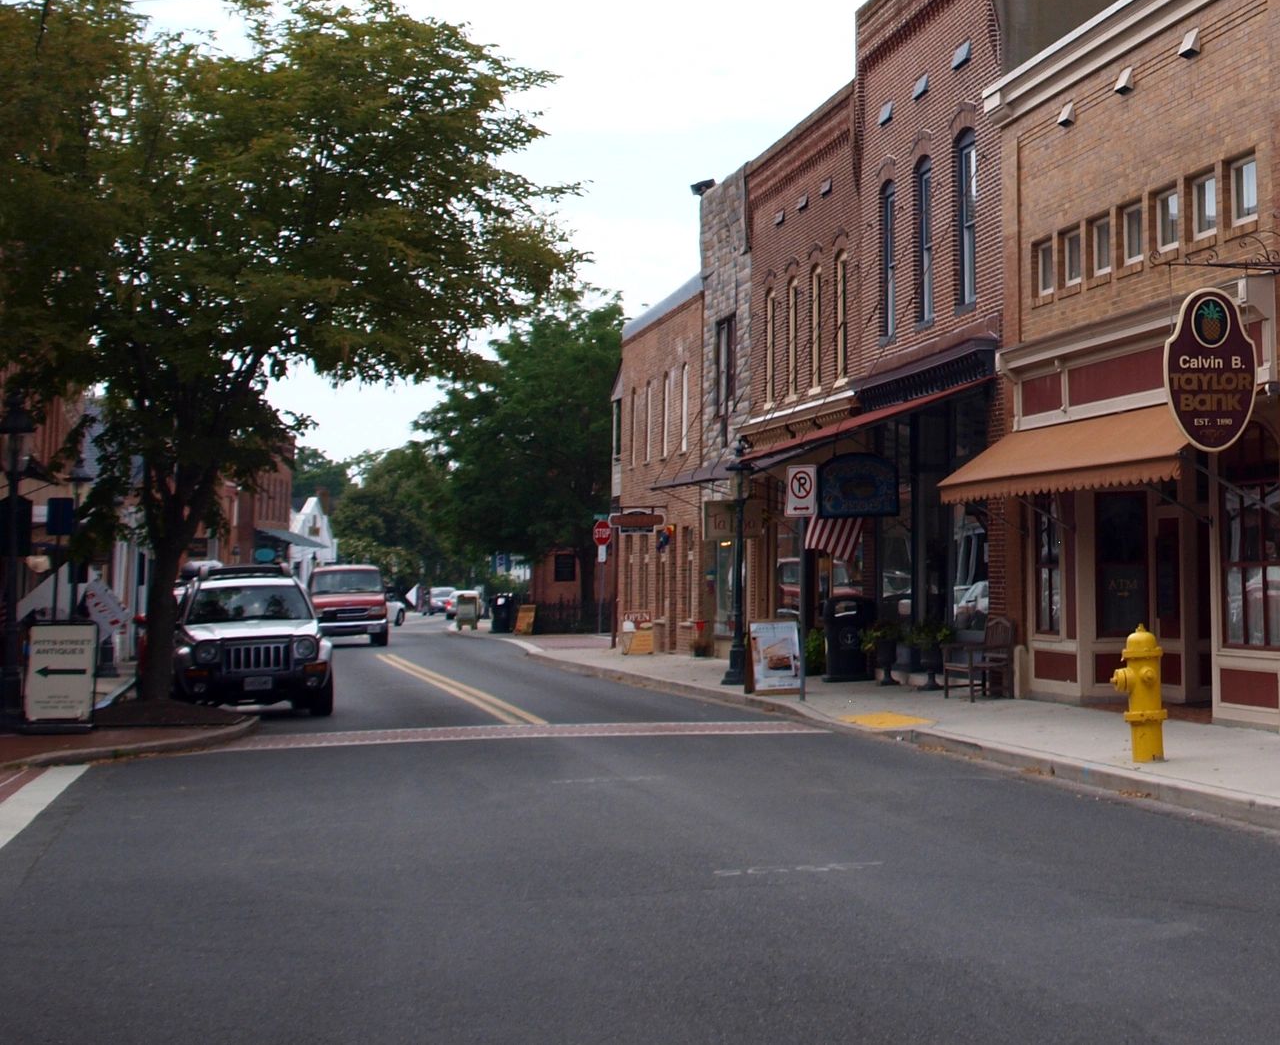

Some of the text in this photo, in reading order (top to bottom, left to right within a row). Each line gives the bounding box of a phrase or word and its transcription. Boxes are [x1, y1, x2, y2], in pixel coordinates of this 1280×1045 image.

[1179, 355, 1246, 369] Calvin B.
[1194, 418, 1212, 426] EST.
[594, 531, 611, 539] STOP
[624, 612, 650, 621] OPEN
[35, 647, 85, 655] ANTIQUES
